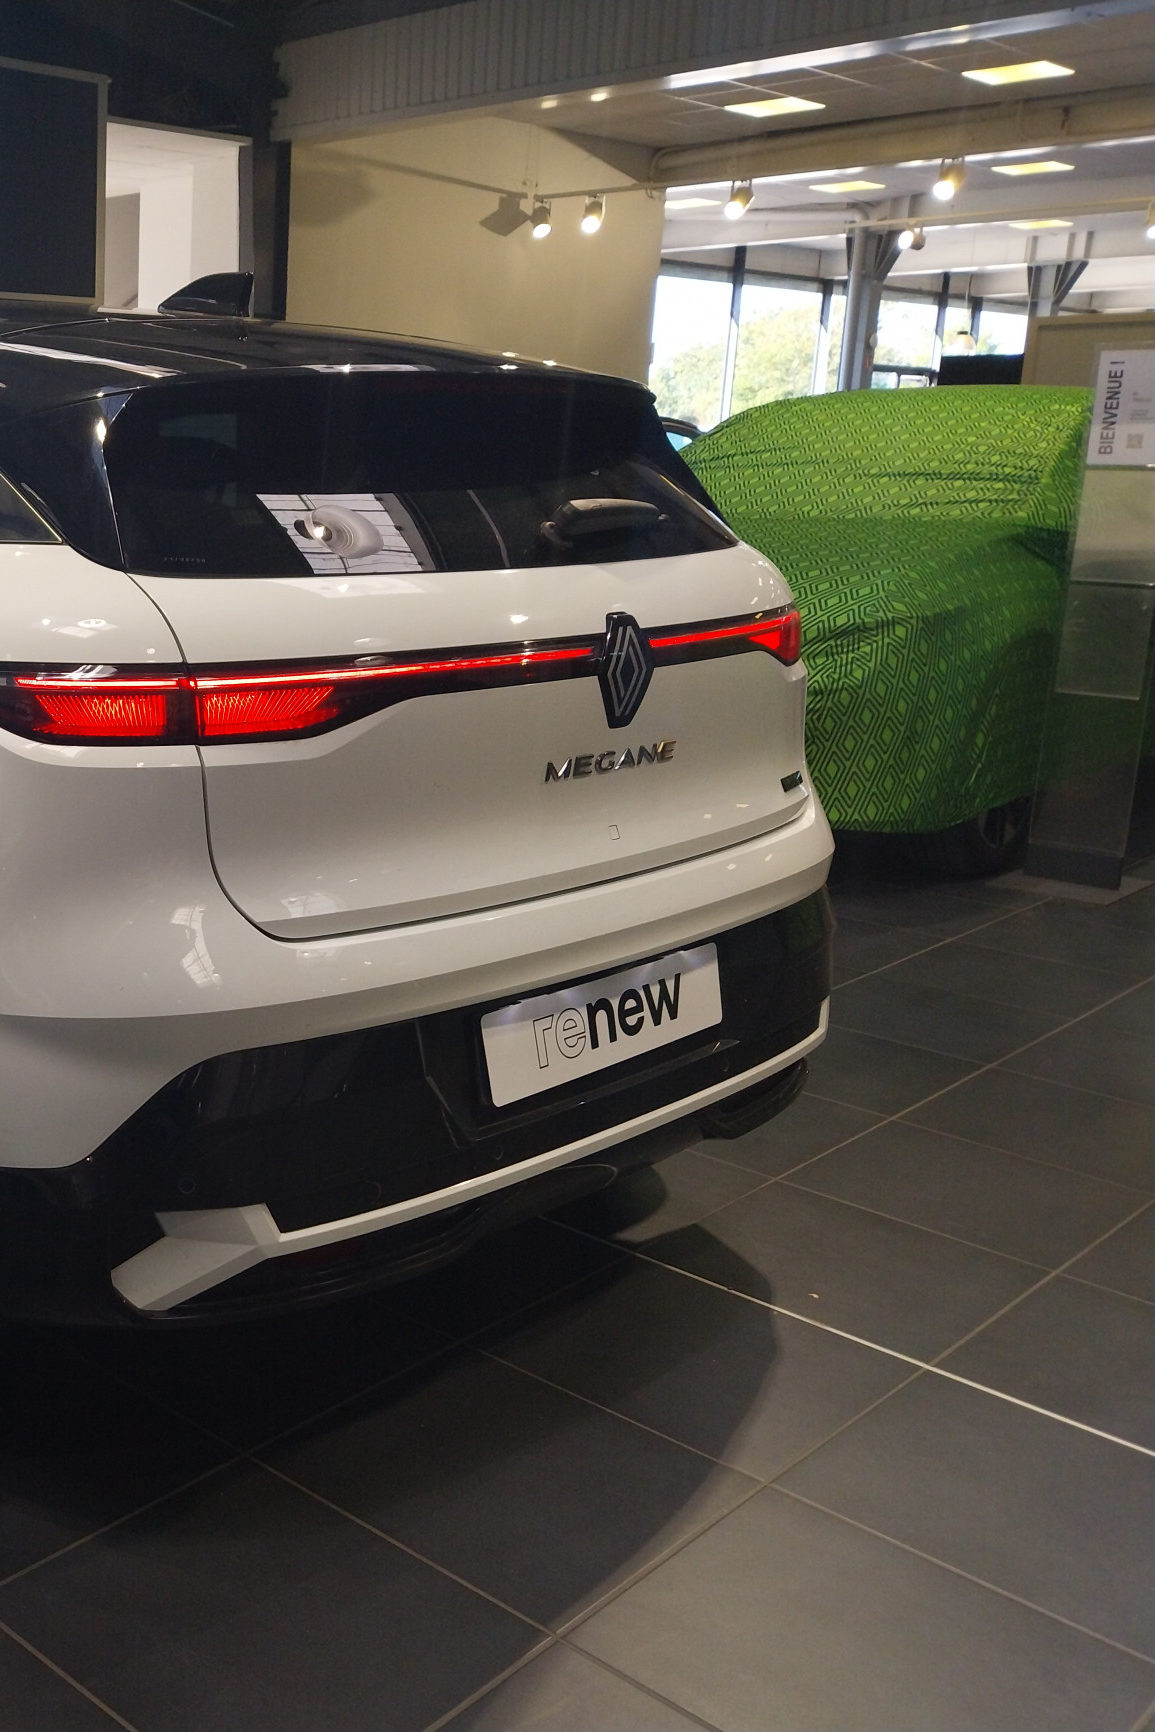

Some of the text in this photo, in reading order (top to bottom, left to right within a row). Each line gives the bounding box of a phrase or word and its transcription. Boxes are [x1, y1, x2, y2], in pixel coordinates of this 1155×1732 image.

[1098, 369, 1124, 455] BIENVENUE
[544, 739, 677, 782] MEGANE
[533, 972, 682, 1069] renew
